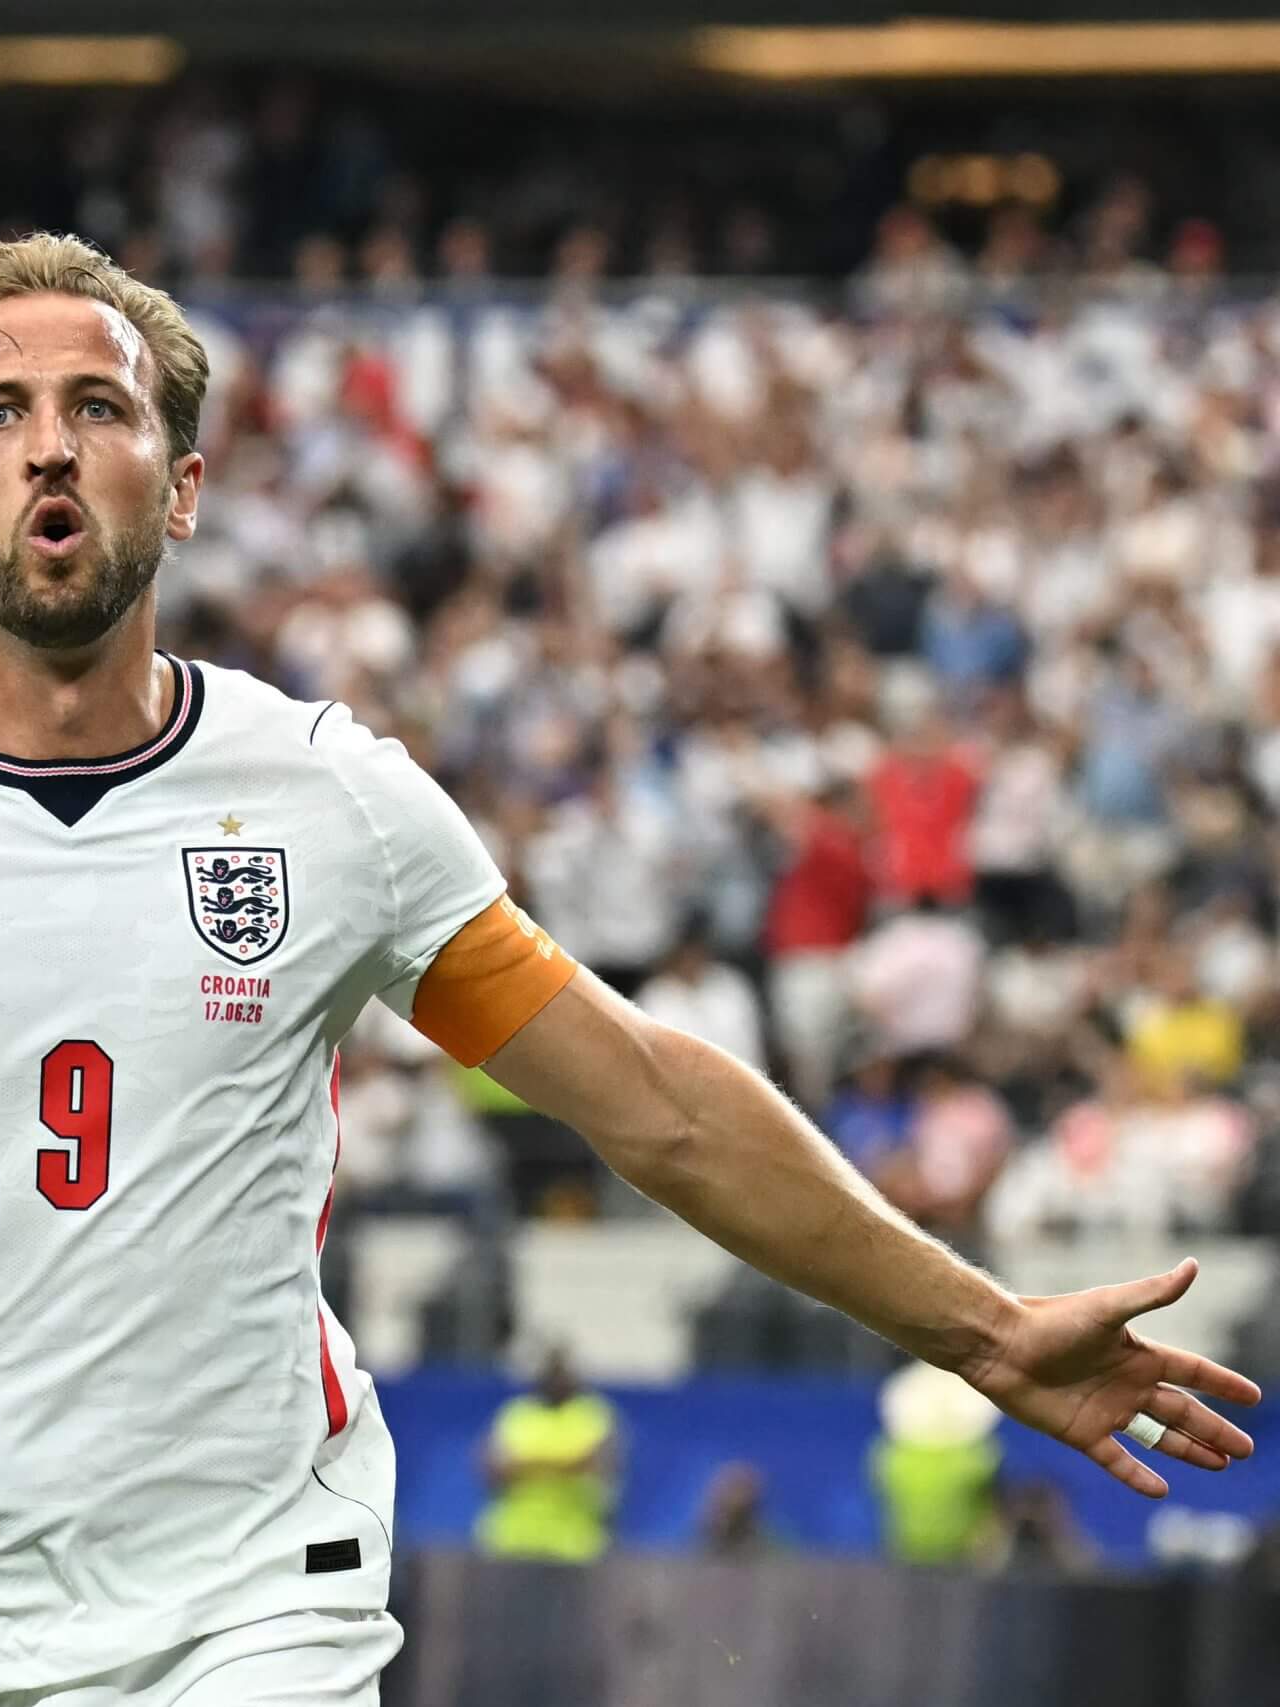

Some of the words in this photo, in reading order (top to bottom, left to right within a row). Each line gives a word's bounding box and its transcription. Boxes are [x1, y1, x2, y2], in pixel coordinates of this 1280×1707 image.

[200, 975, 271, 998] CROATIA
[205, 1001, 263, 1023] 17.06.26
[36, 1039, 114, 1211] 9
